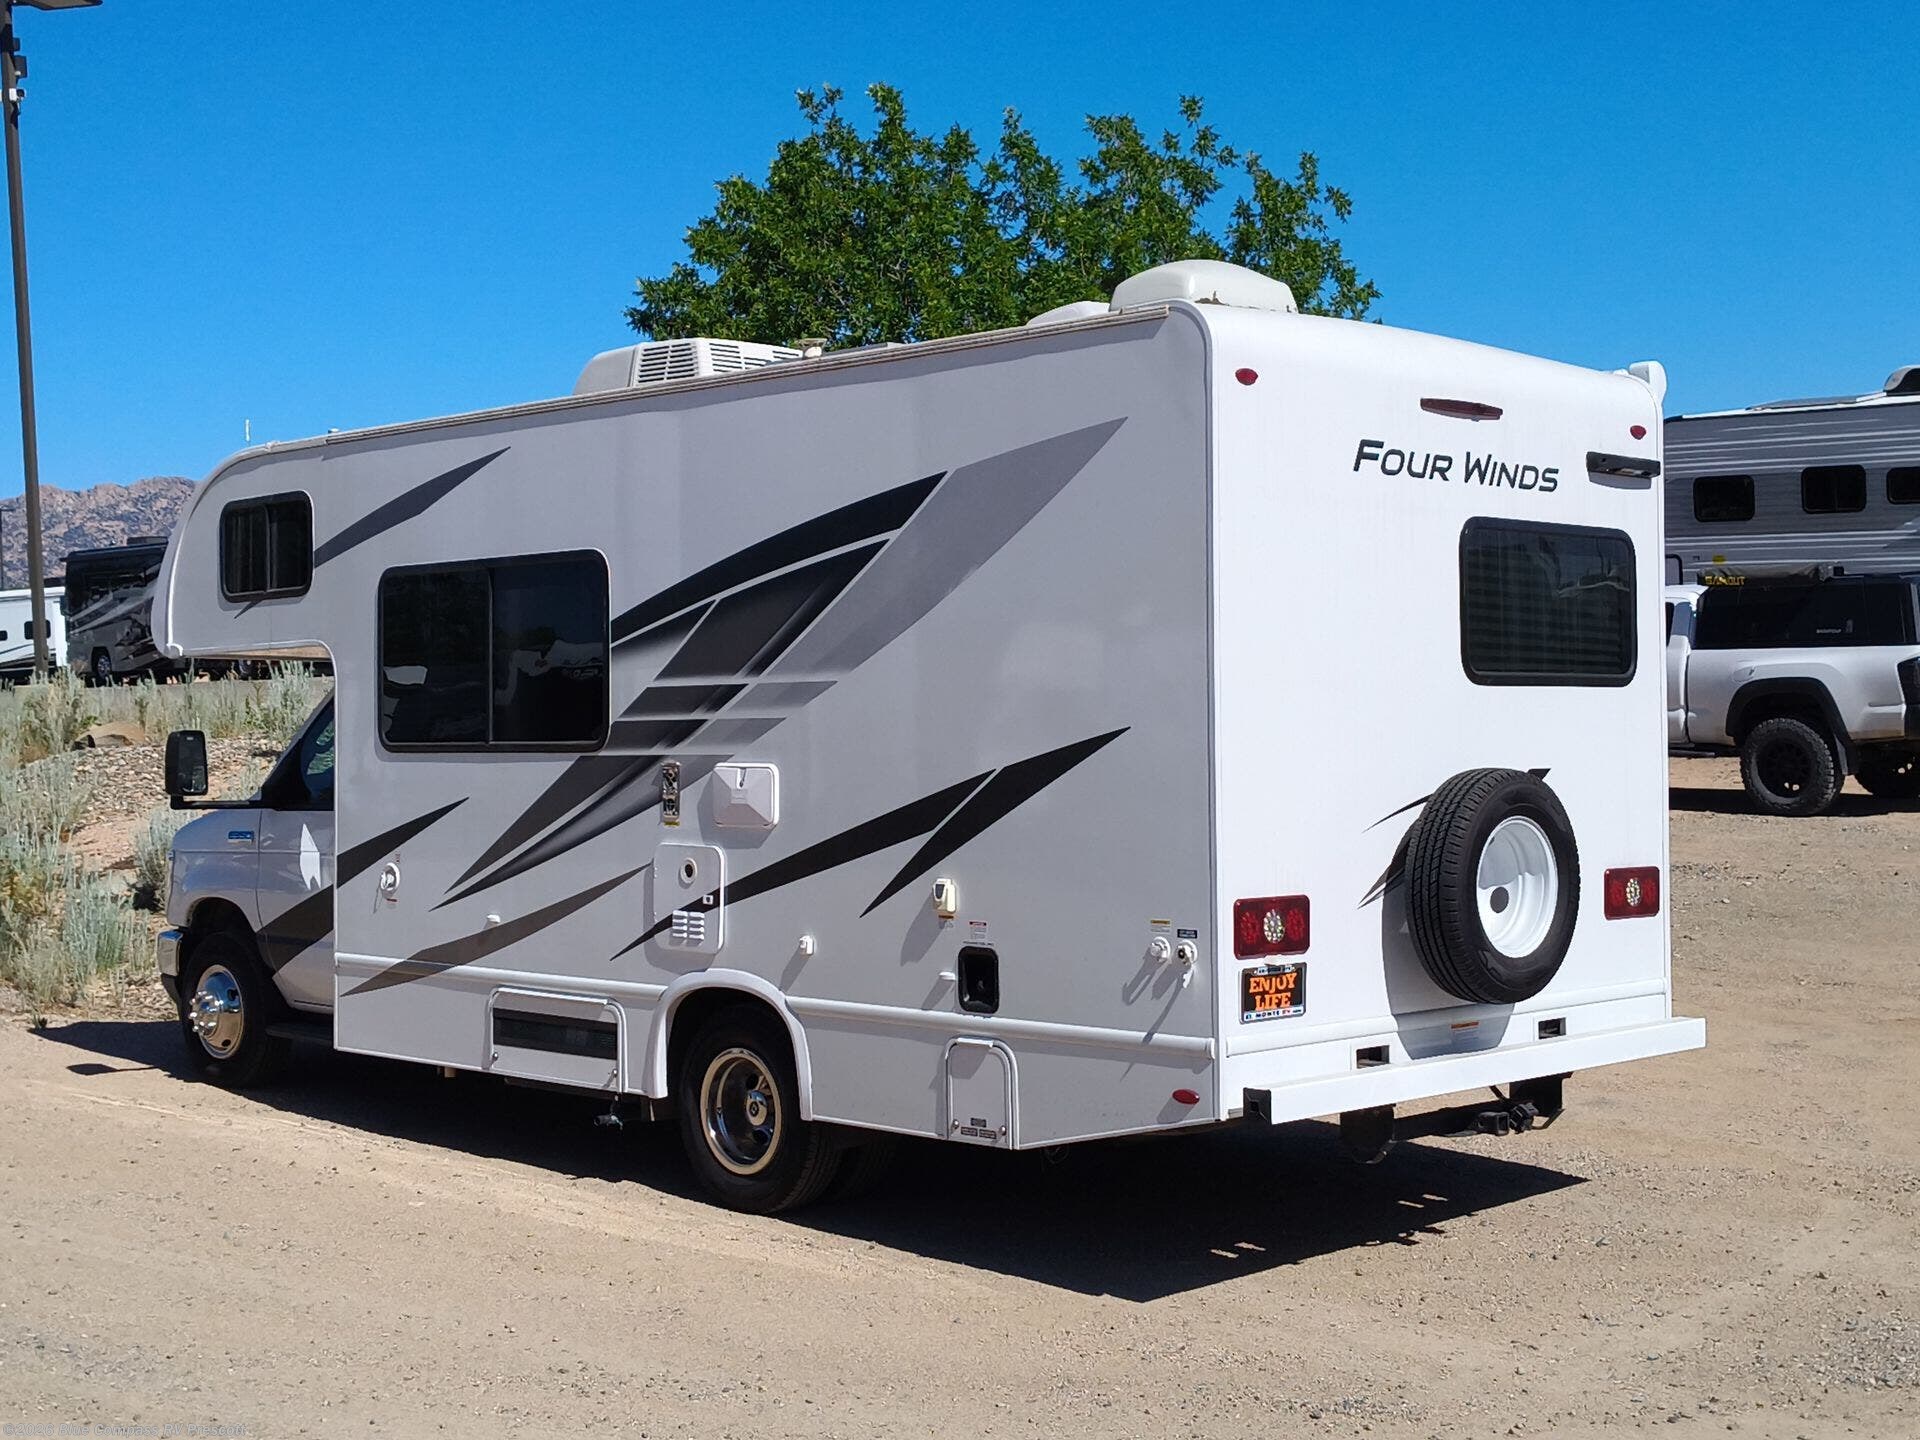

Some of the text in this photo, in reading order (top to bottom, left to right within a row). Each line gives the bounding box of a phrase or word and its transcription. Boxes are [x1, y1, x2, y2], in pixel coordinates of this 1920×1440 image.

[1353, 439, 1559, 492] FOUR WINDS
[1249, 973, 1297, 993] ENJOY
[1255, 992, 1291, 1010] LIFE
